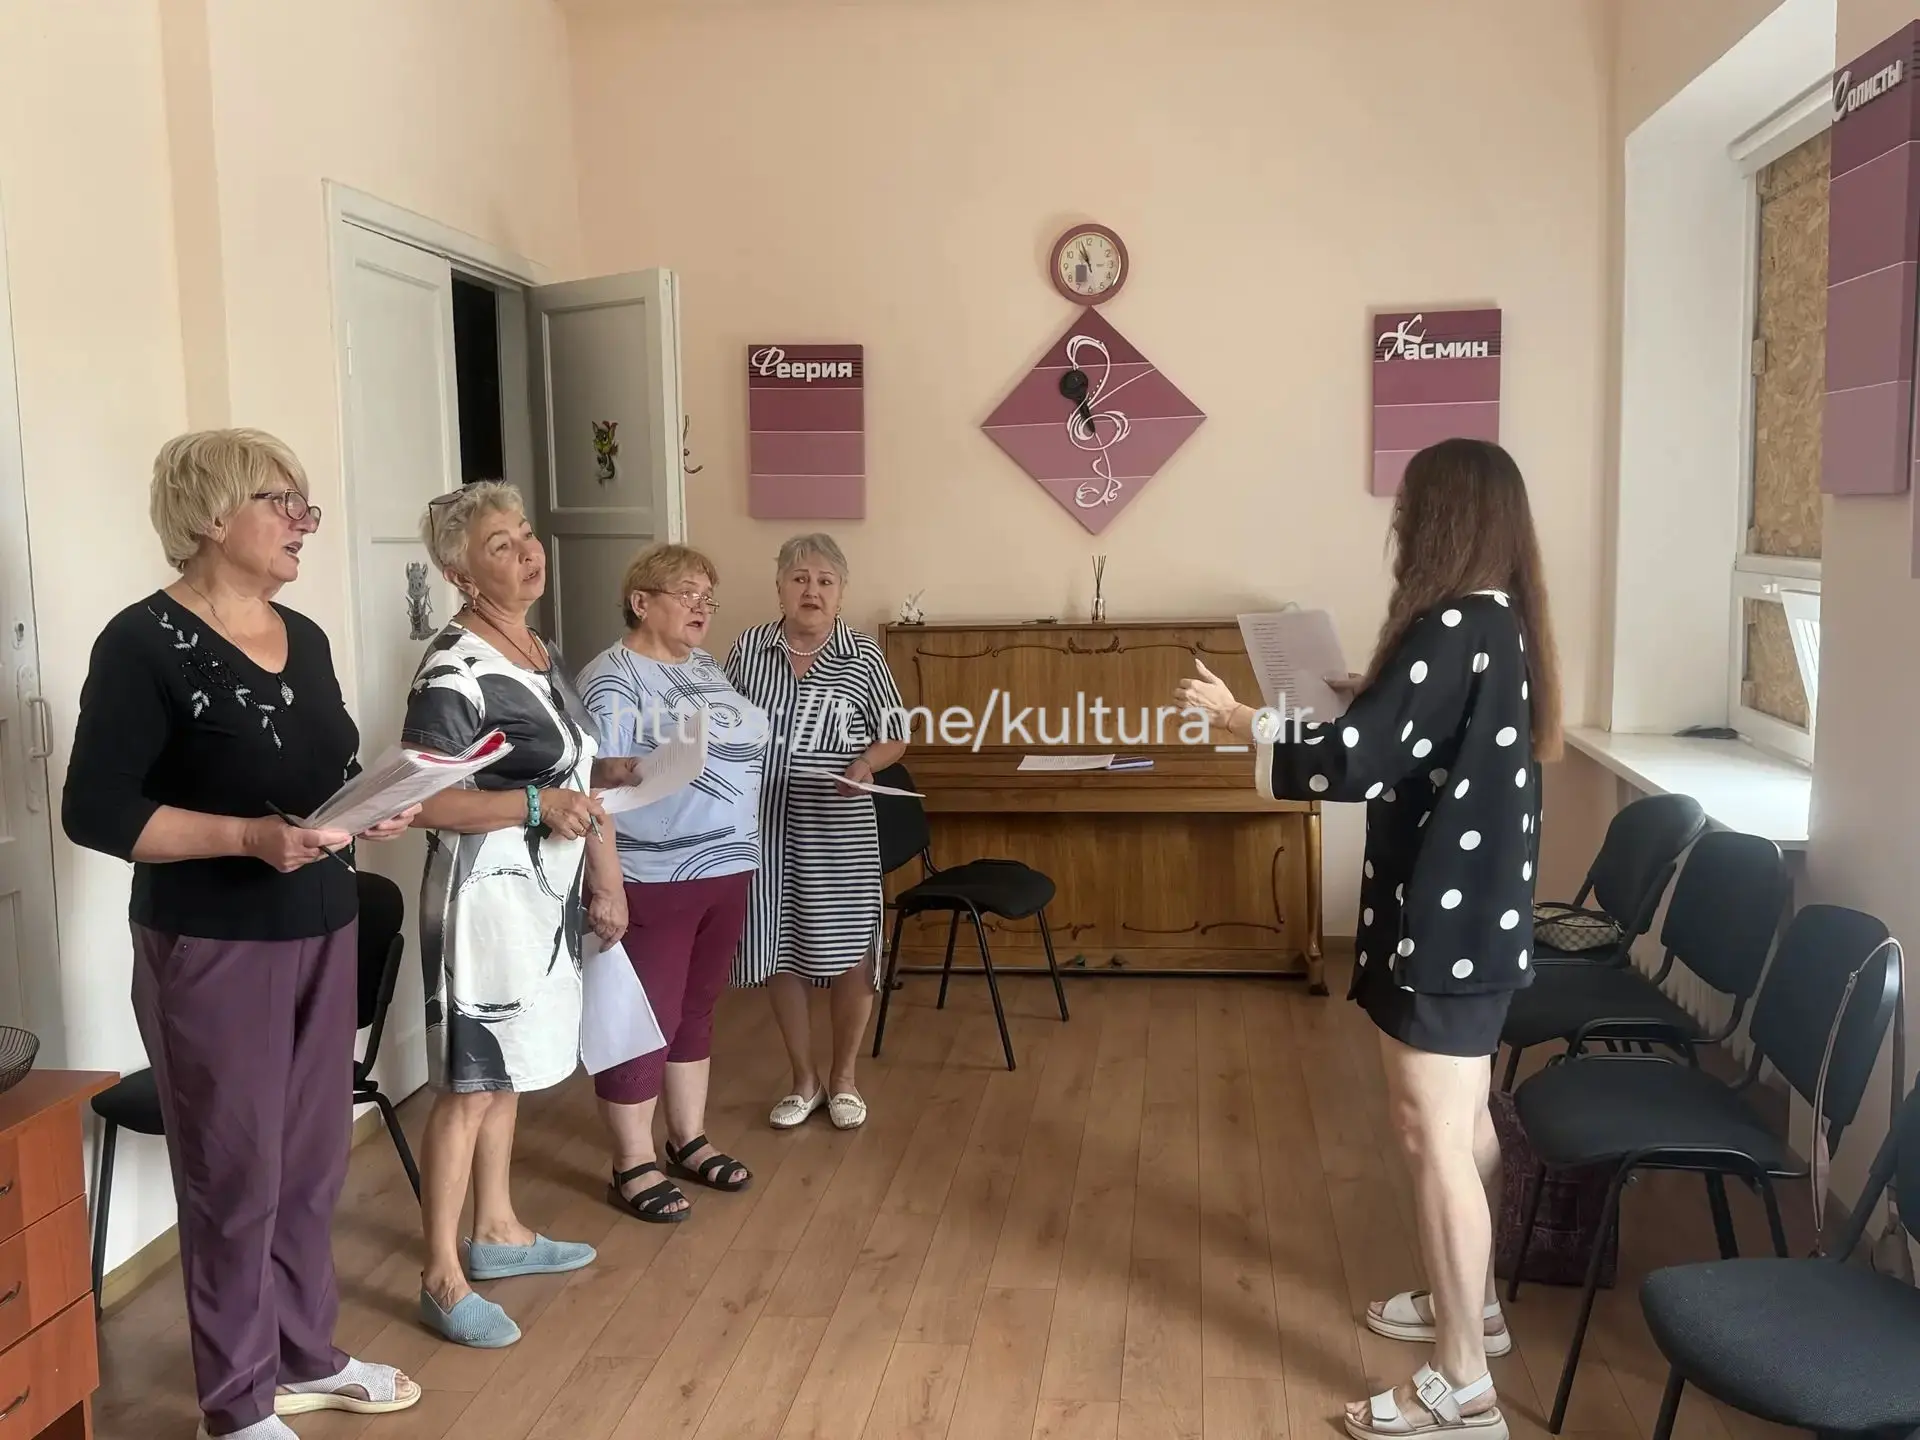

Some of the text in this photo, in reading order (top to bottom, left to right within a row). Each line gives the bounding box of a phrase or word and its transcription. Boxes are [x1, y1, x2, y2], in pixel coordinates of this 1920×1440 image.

[1832, 59, 1904, 122] Солисты
[1086, 237, 1093, 246] 12
[1066, 250, 1074, 259] 10
[1104, 249, 1111, 258] 2
[1063, 262, 1069, 271] 9
[1067, 274, 1073, 283] 8
[1087, 285, 1093, 293] 6
[1099, 282, 1105, 290] 5
[1378, 313, 1488, 361] Жасмин
[751, 346, 853, 382] Феерия
